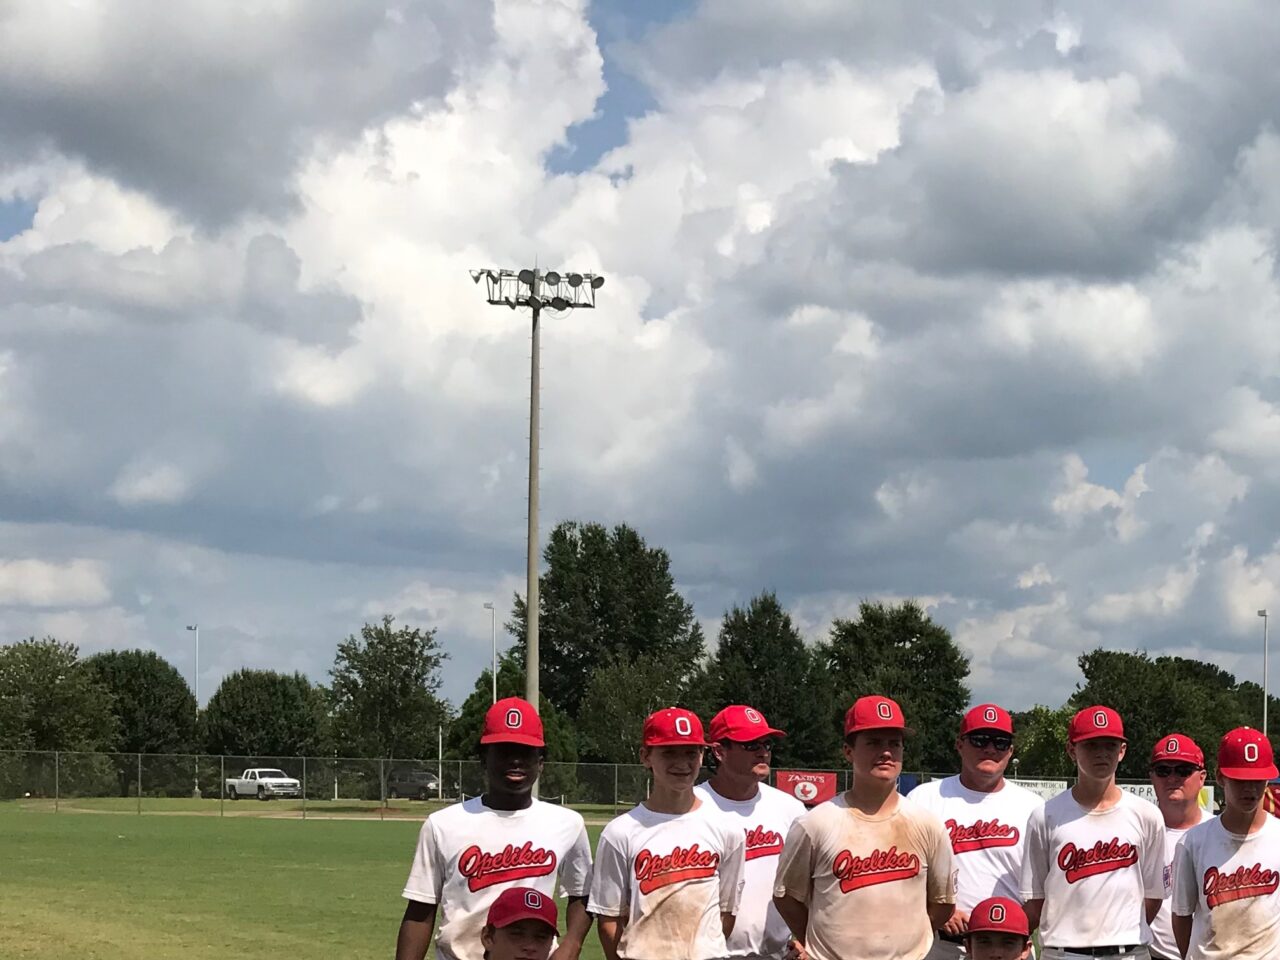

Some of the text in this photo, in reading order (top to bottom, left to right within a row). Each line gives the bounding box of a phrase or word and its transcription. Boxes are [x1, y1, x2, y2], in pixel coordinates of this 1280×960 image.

[506, 708, 522, 728] O
[745, 707, 761, 723] O
[877, 702, 893, 720] O
[984, 707, 998, 723] O
[1093, 711, 1108, 728] O
[675, 717, 691, 735] O
[1165, 738, 1179, 753] O
[1244, 743, 1258, 761] O
[459, 841, 556, 880] Opelika
[635, 844, 719, 880] Opelika
[833, 846, 920, 882] Opelika
[1058, 837, 1138, 872] Opelika
[1204, 863, 1279, 898] Opelika
[525, 890, 542, 909] O
[989, 904, 1005, 923] O
